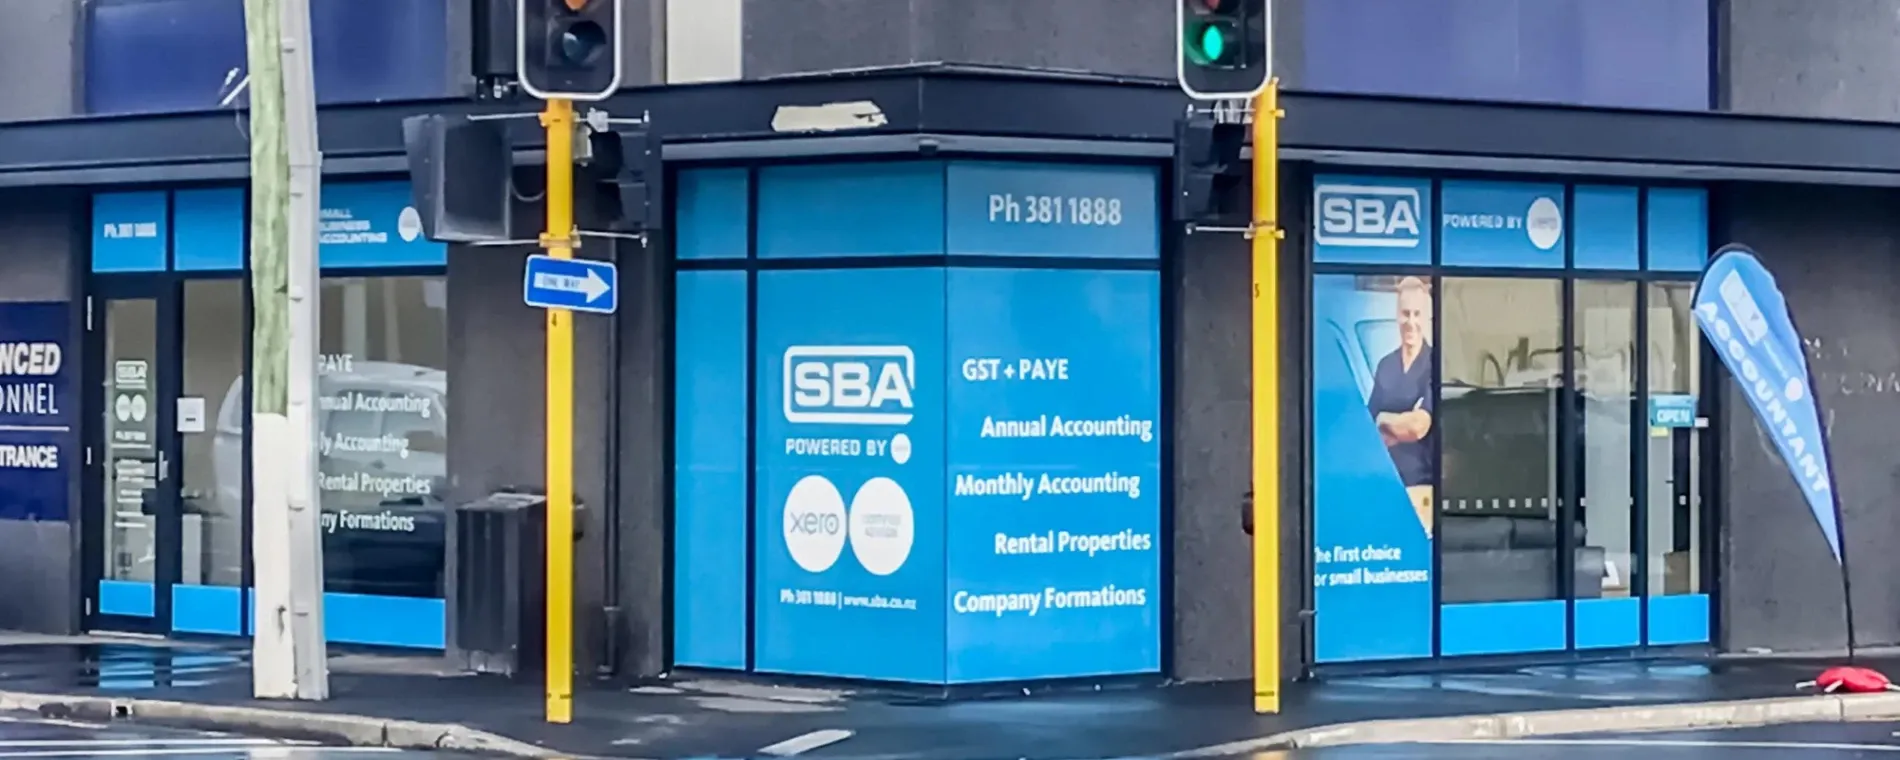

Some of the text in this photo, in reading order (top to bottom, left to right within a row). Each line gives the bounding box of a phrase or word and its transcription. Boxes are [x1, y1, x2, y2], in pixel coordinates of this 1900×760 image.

[989, 194, 1122, 226] Ph 381 1888
[1323, 197, 1419, 235] SBA
[1443, 213, 1503, 229] POWERED
[1507, 214, 1522, 229] BY
[962, 358, 1000, 381] GST
[1019, 358, 1069, 380] PAYE
[795, 361, 914, 408] SBA
[1697, 301, 1829, 492] ACCOUNTANT
[355, 392, 431, 418] Accounting
[1656, 408, 1691, 423] OPEN
[980, 414, 1153, 442] Annual Accounting
[334, 431, 409, 459] Accounting
[785, 438, 887, 457] POWERED BY
[361, 472, 431, 497] Properties
[955, 471, 1141, 501] Monthly Accounting
[339, 508, 415, 532] Formations
[790, 512, 839, 535] xero
[994, 528, 1152, 557] Rental Properties
[1333, 545, 1360, 562] first
[1361, 544, 1401, 560] choice
[1329, 567, 1362, 586] small
[1363, 567, 1428, 584] businesses
[953, 584, 1147, 617] Company Formations
